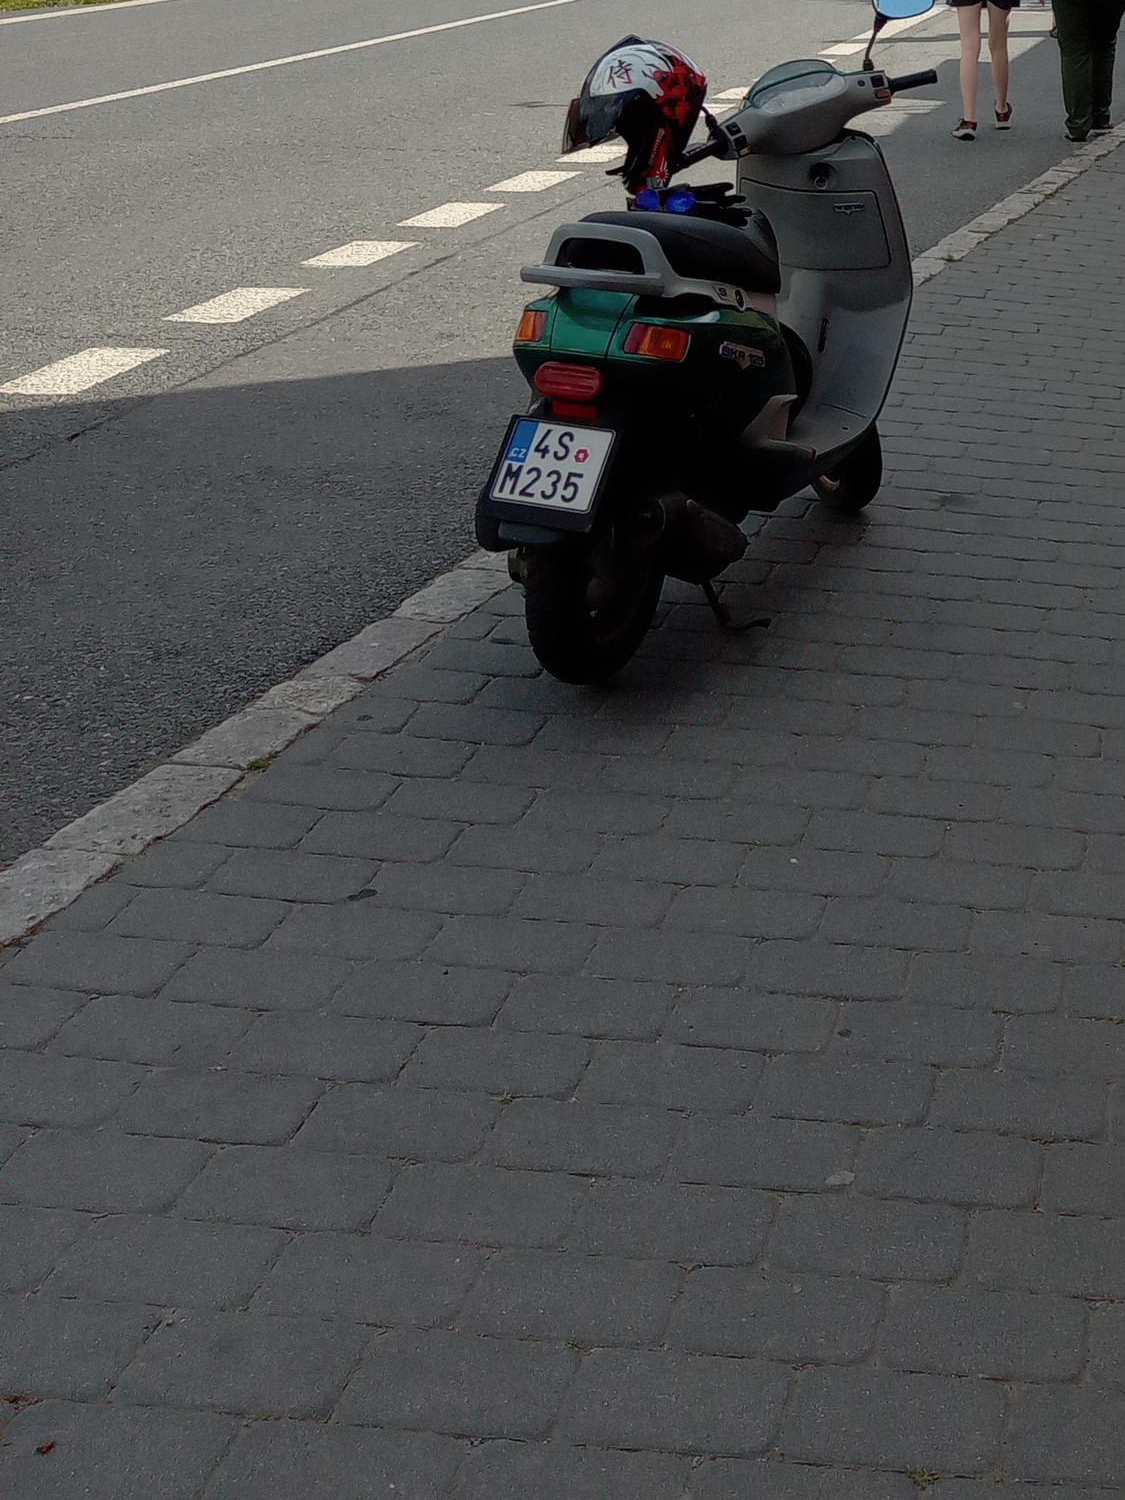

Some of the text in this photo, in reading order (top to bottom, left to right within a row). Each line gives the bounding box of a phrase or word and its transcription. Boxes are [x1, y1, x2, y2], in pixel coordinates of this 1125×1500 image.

[510, 447, 527, 459] CZ
[533, 429, 574, 461] 4S
[498, 463, 583, 503] M235
